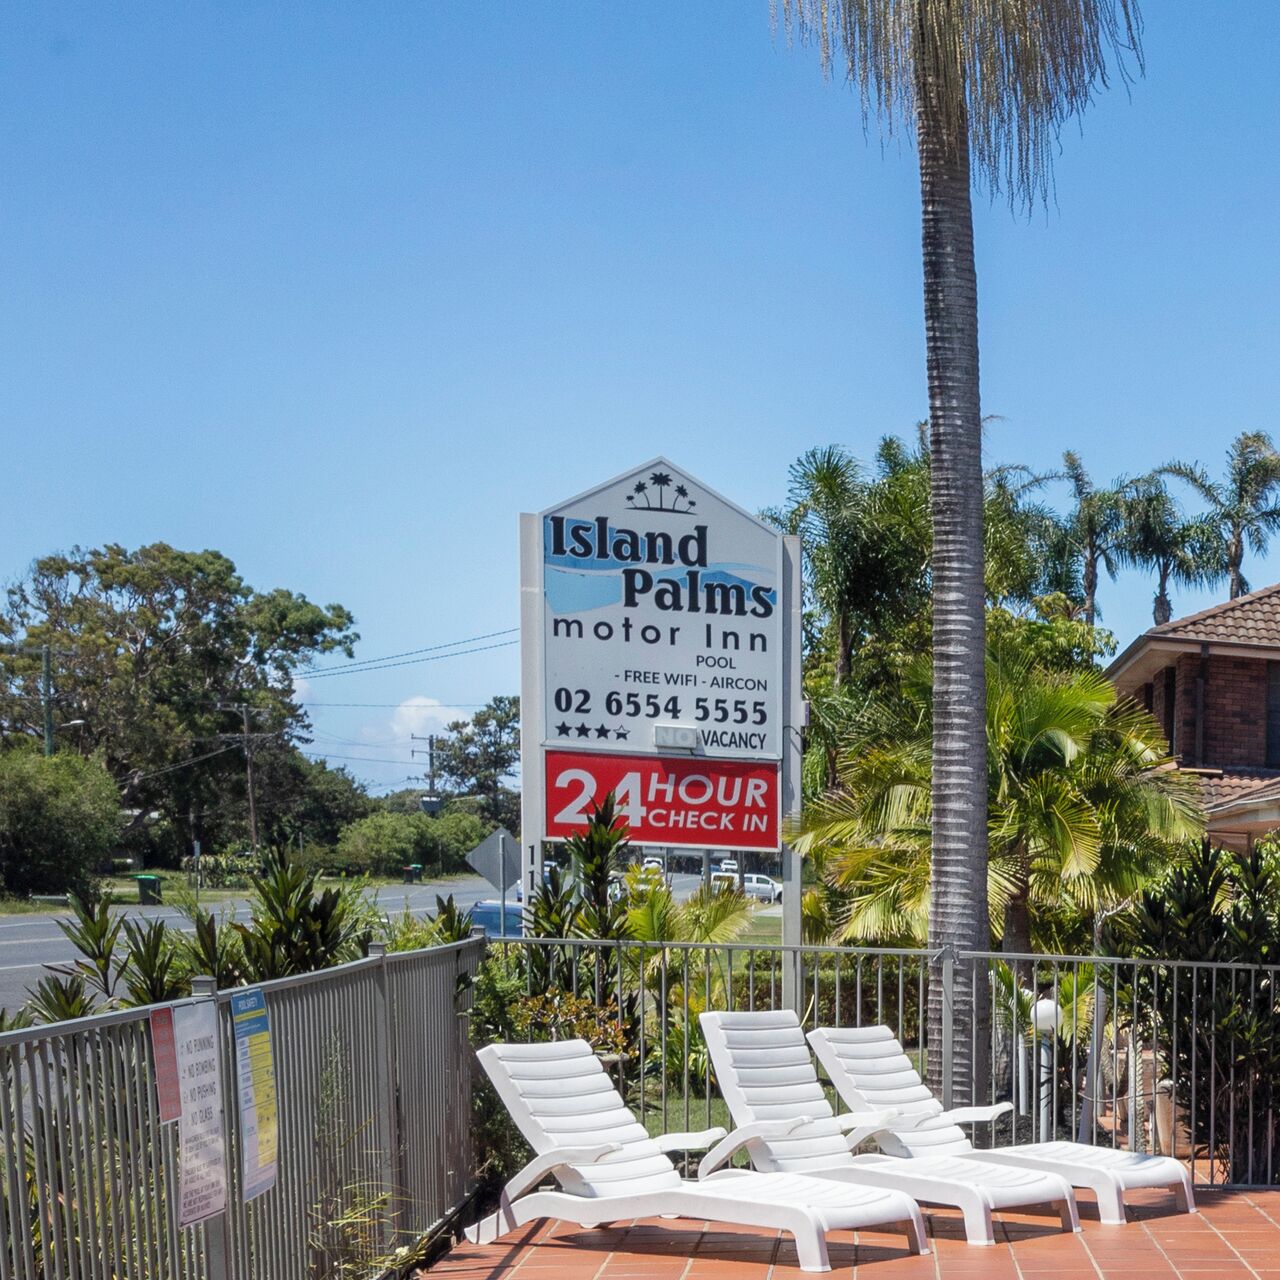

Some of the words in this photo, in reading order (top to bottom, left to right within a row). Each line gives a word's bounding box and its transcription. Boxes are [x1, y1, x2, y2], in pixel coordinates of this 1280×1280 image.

[550, 515, 709, 568] Island
[622, 567, 774, 619] Palms
[552, 616, 681, 645] motor
[705, 623, 768, 652] Inn
[696, 654, 737, 670] POOL
[624, 669, 661, 685] FREE
[664, 672, 697, 687] WIFI
[709, 676, 768, 692] AIRCON
[554, 687, 592, 714] 02
[605, 690, 682, 720] 6554
[694, 697, 768, 726] 5555
[661, 728, 694, 743] NO
[702, 729, 767, 750] VACANCY
[553, 768, 648, 828] 24
[647, 772, 769, 809] HOUR
[648, 808, 735, 831] CHECK
[742, 814, 769, 833] IN
